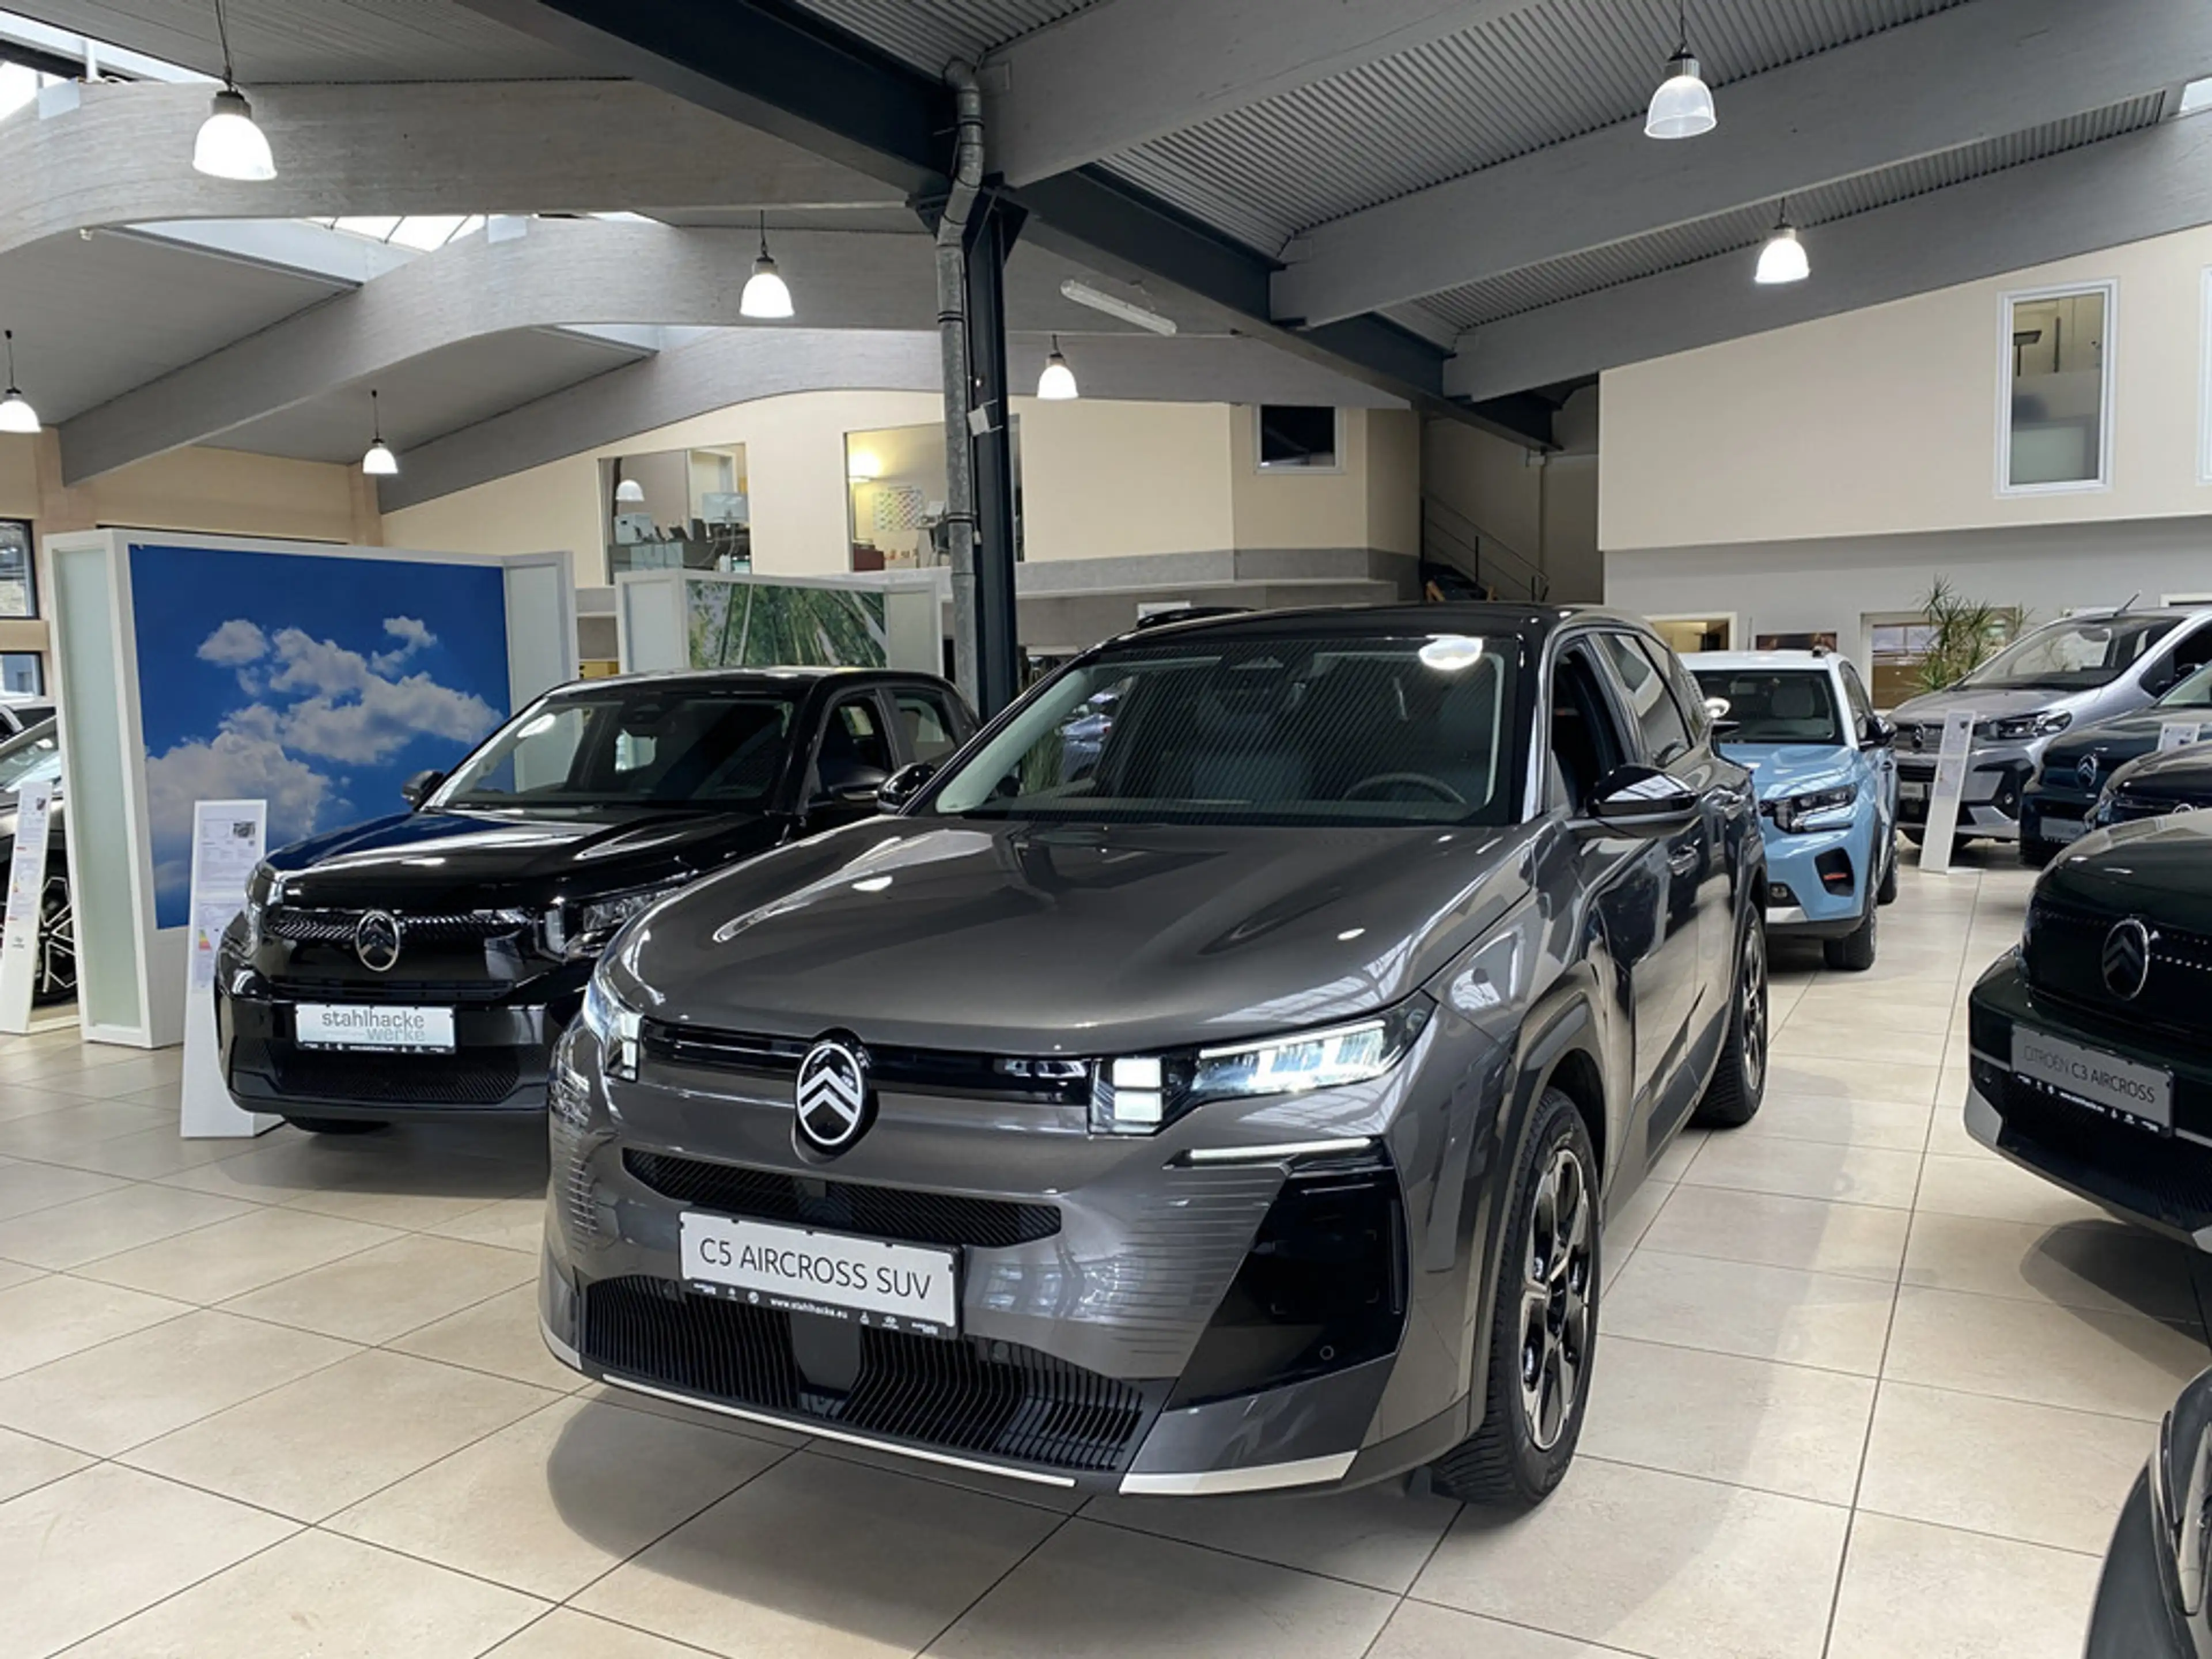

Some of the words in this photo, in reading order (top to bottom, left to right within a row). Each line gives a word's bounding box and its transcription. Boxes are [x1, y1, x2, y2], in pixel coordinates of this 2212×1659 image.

[321, 1009, 425, 1029] stahlhacke
[365, 1027, 426, 1041] werke
[2071, 1062, 2088, 1081] C3
[2090, 1069, 2156, 1104] AIRCROSS
[700, 1237, 732, 1267] C5
[739, 1244, 868, 1290] AIRCROSS
[876, 1266, 931, 1300] SUV
